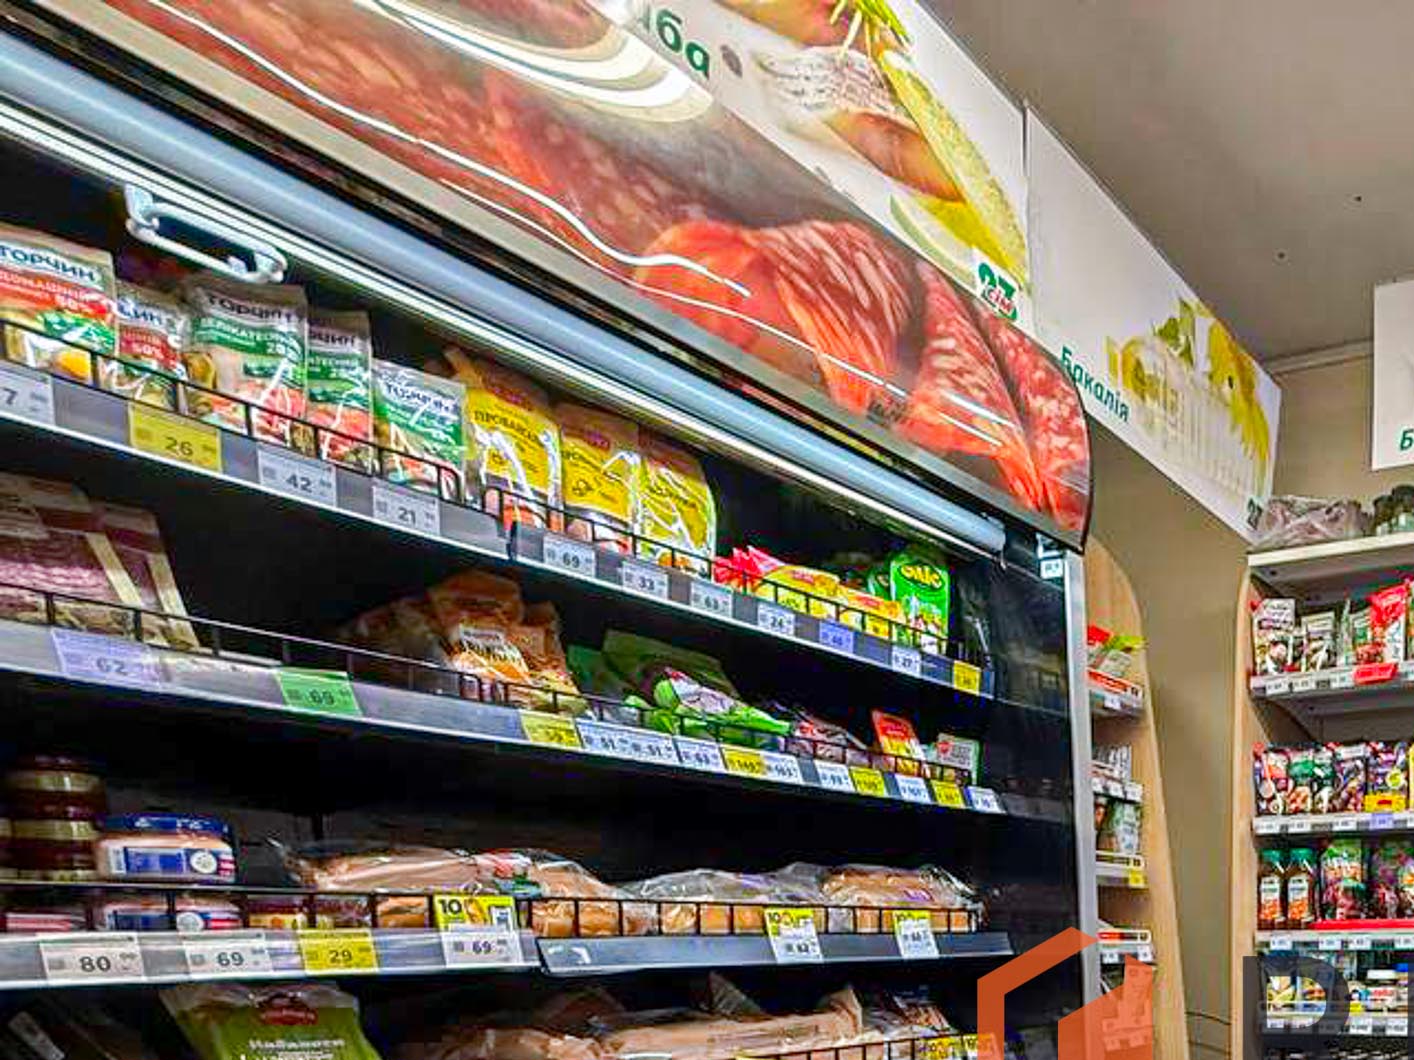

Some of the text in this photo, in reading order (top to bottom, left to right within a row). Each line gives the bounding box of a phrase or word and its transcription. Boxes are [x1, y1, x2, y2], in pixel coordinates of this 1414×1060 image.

[1059, 346, 1131, 422] Бакалія
[165, 436, 194, 458] 26
[285, 472, 312, 492] 42
[398, 506, 416, 525] 21
[471, 939, 492, 954] 69
[79, 955, 112, 973] 80
[216, 952, 245, 967] 69
[329, 949, 354, 964] 29
